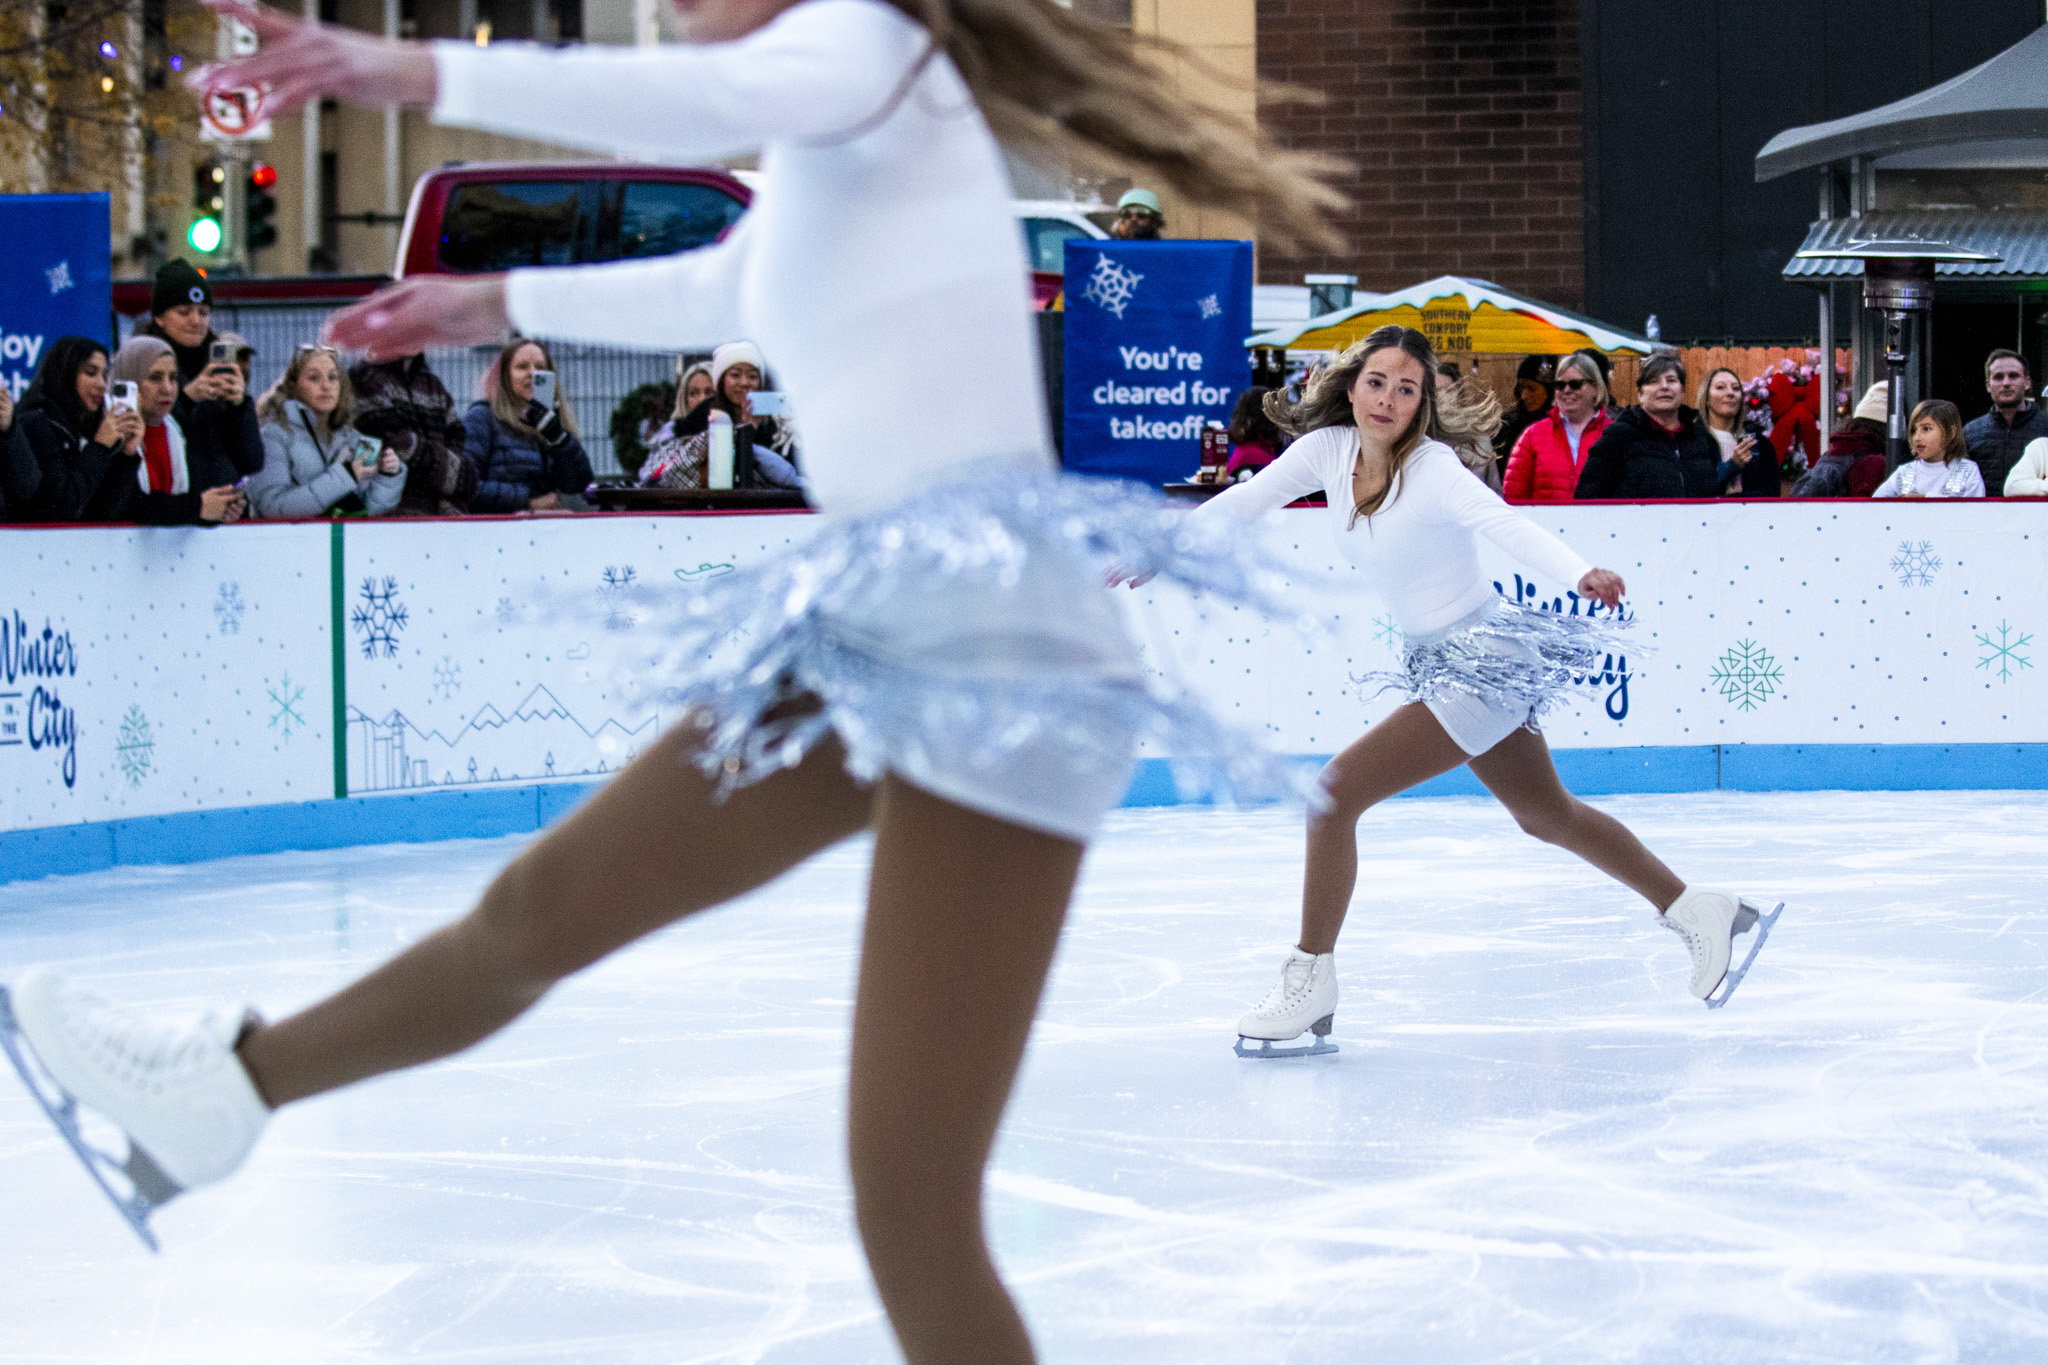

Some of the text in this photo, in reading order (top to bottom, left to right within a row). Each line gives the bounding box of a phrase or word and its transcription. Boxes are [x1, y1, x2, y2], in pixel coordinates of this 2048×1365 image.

[1420, 308, 1471, 321] SOUTHERN
[1423, 322, 1468, 334] COMFORT
[1119, 345, 1203, 371] You're
[1093, 379, 1231, 405] cleared for
[1110, 415, 1204, 440] takeoff
[28, 684, 77, 789] City
